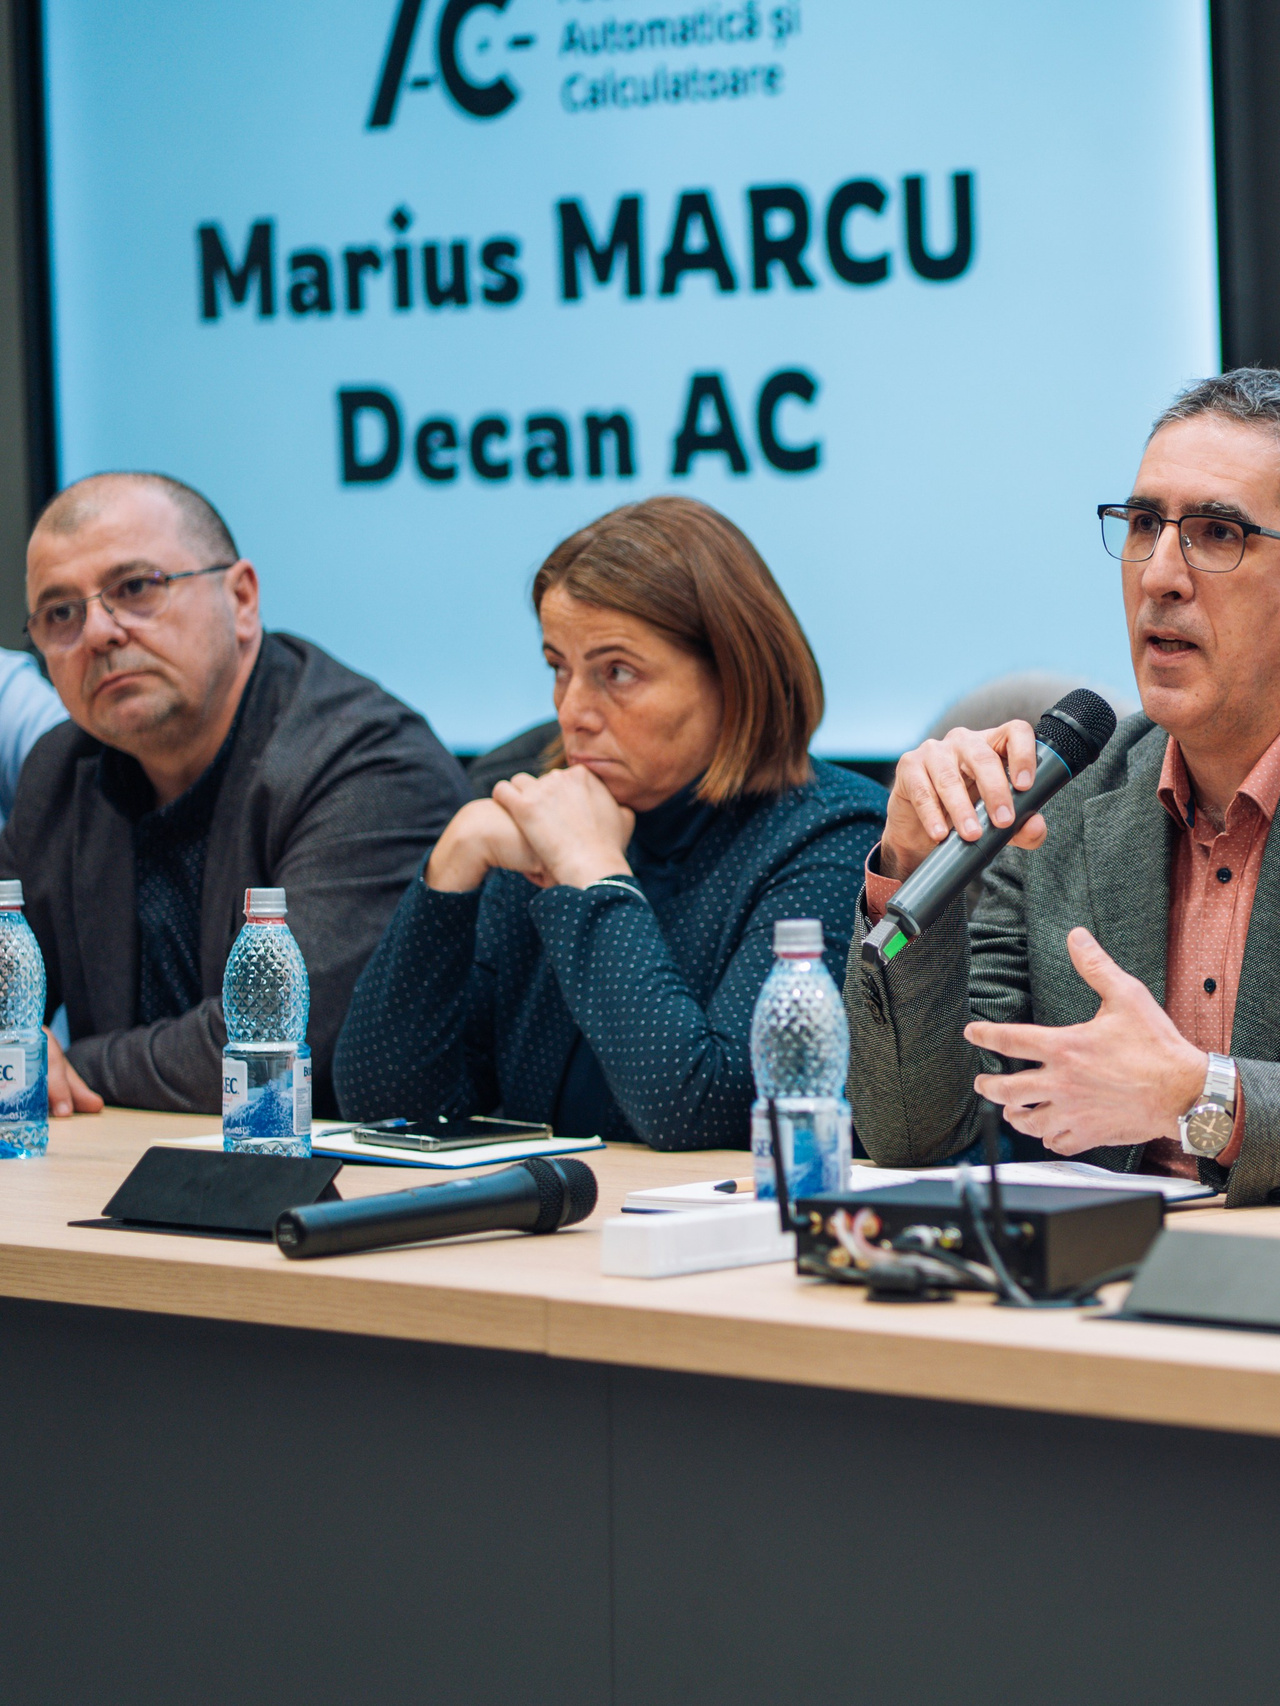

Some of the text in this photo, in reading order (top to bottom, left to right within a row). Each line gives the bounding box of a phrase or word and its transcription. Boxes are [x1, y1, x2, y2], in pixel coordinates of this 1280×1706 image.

[560, 62, 785, 114] Calculatoare
[194, 170, 976, 325] Marius MARCU
[335, 367, 821, 488] Decan AC
